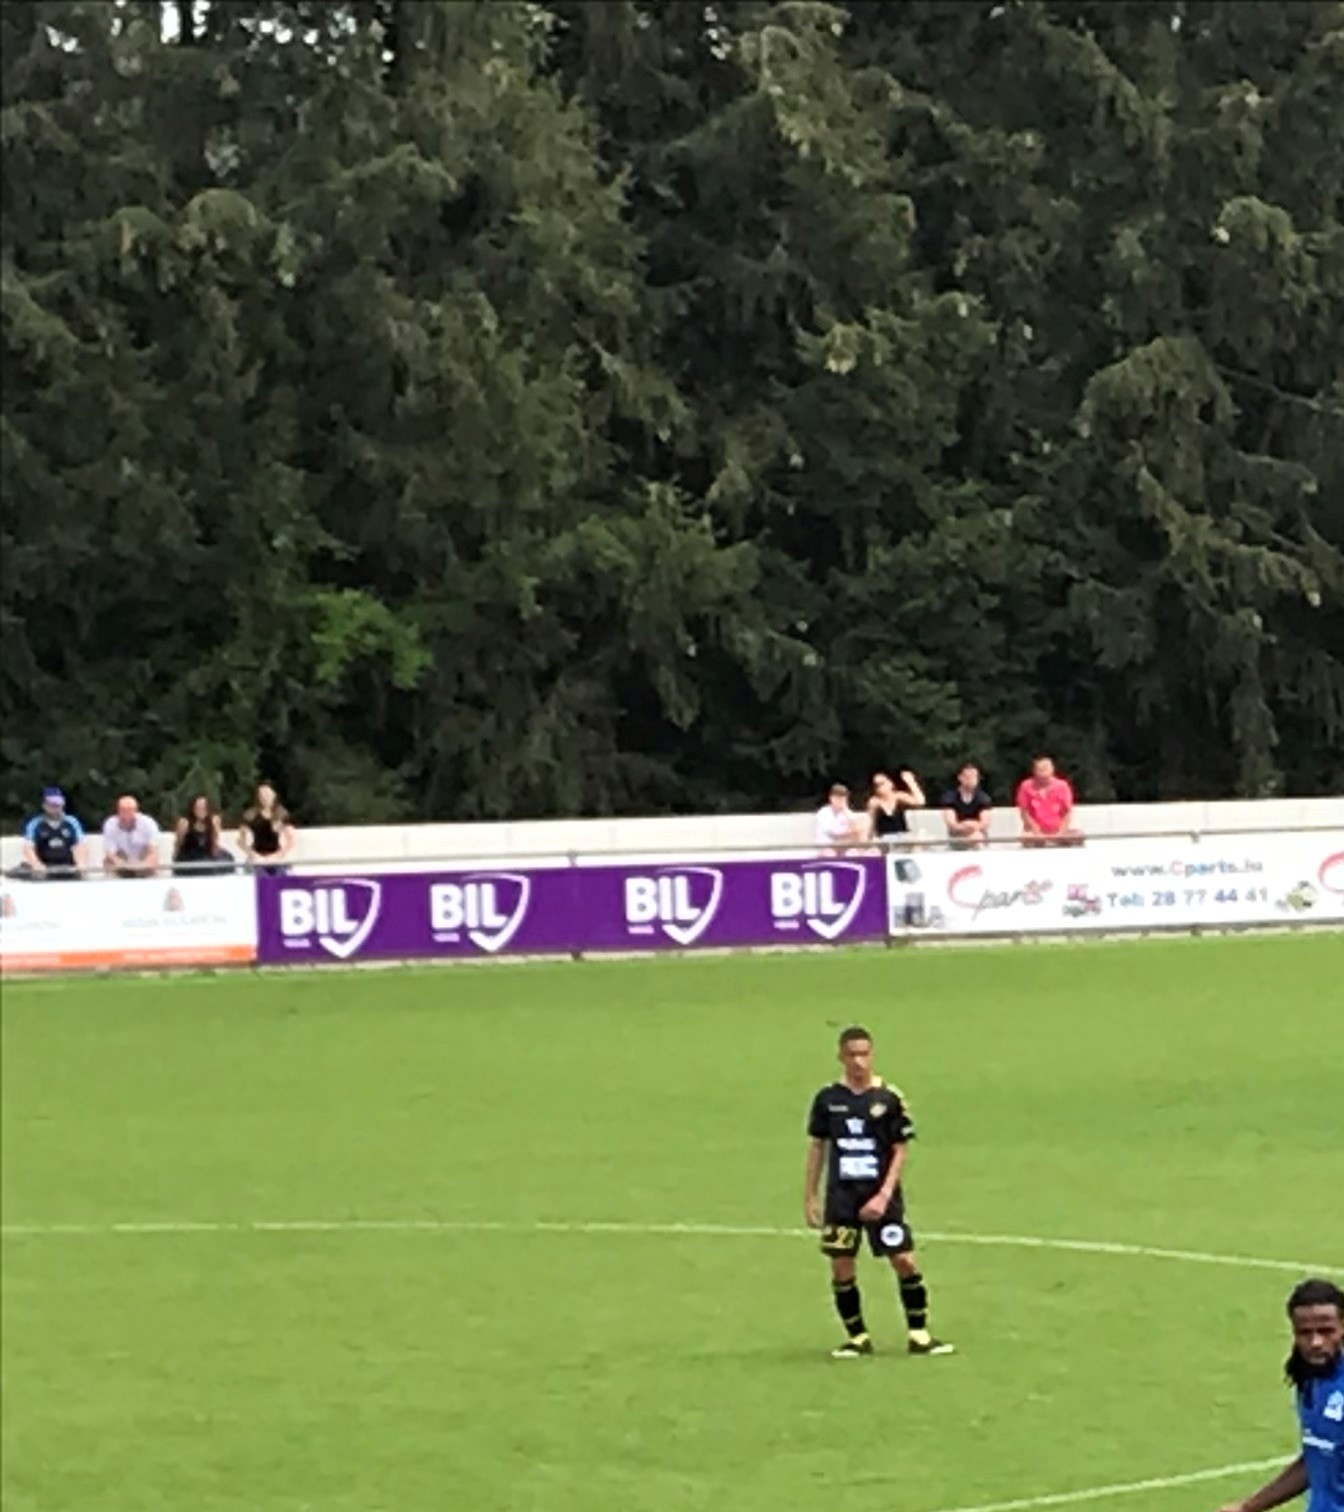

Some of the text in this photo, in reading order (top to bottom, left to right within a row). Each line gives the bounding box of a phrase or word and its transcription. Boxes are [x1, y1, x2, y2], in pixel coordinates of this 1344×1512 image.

[280, 888, 358, 935] BIL
[430, 883, 508, 929] BIL
[625, 875, 701, 922] BIL
[771, 870, 845, 917] BIL
[1183, 888, 1208, 906] 77
